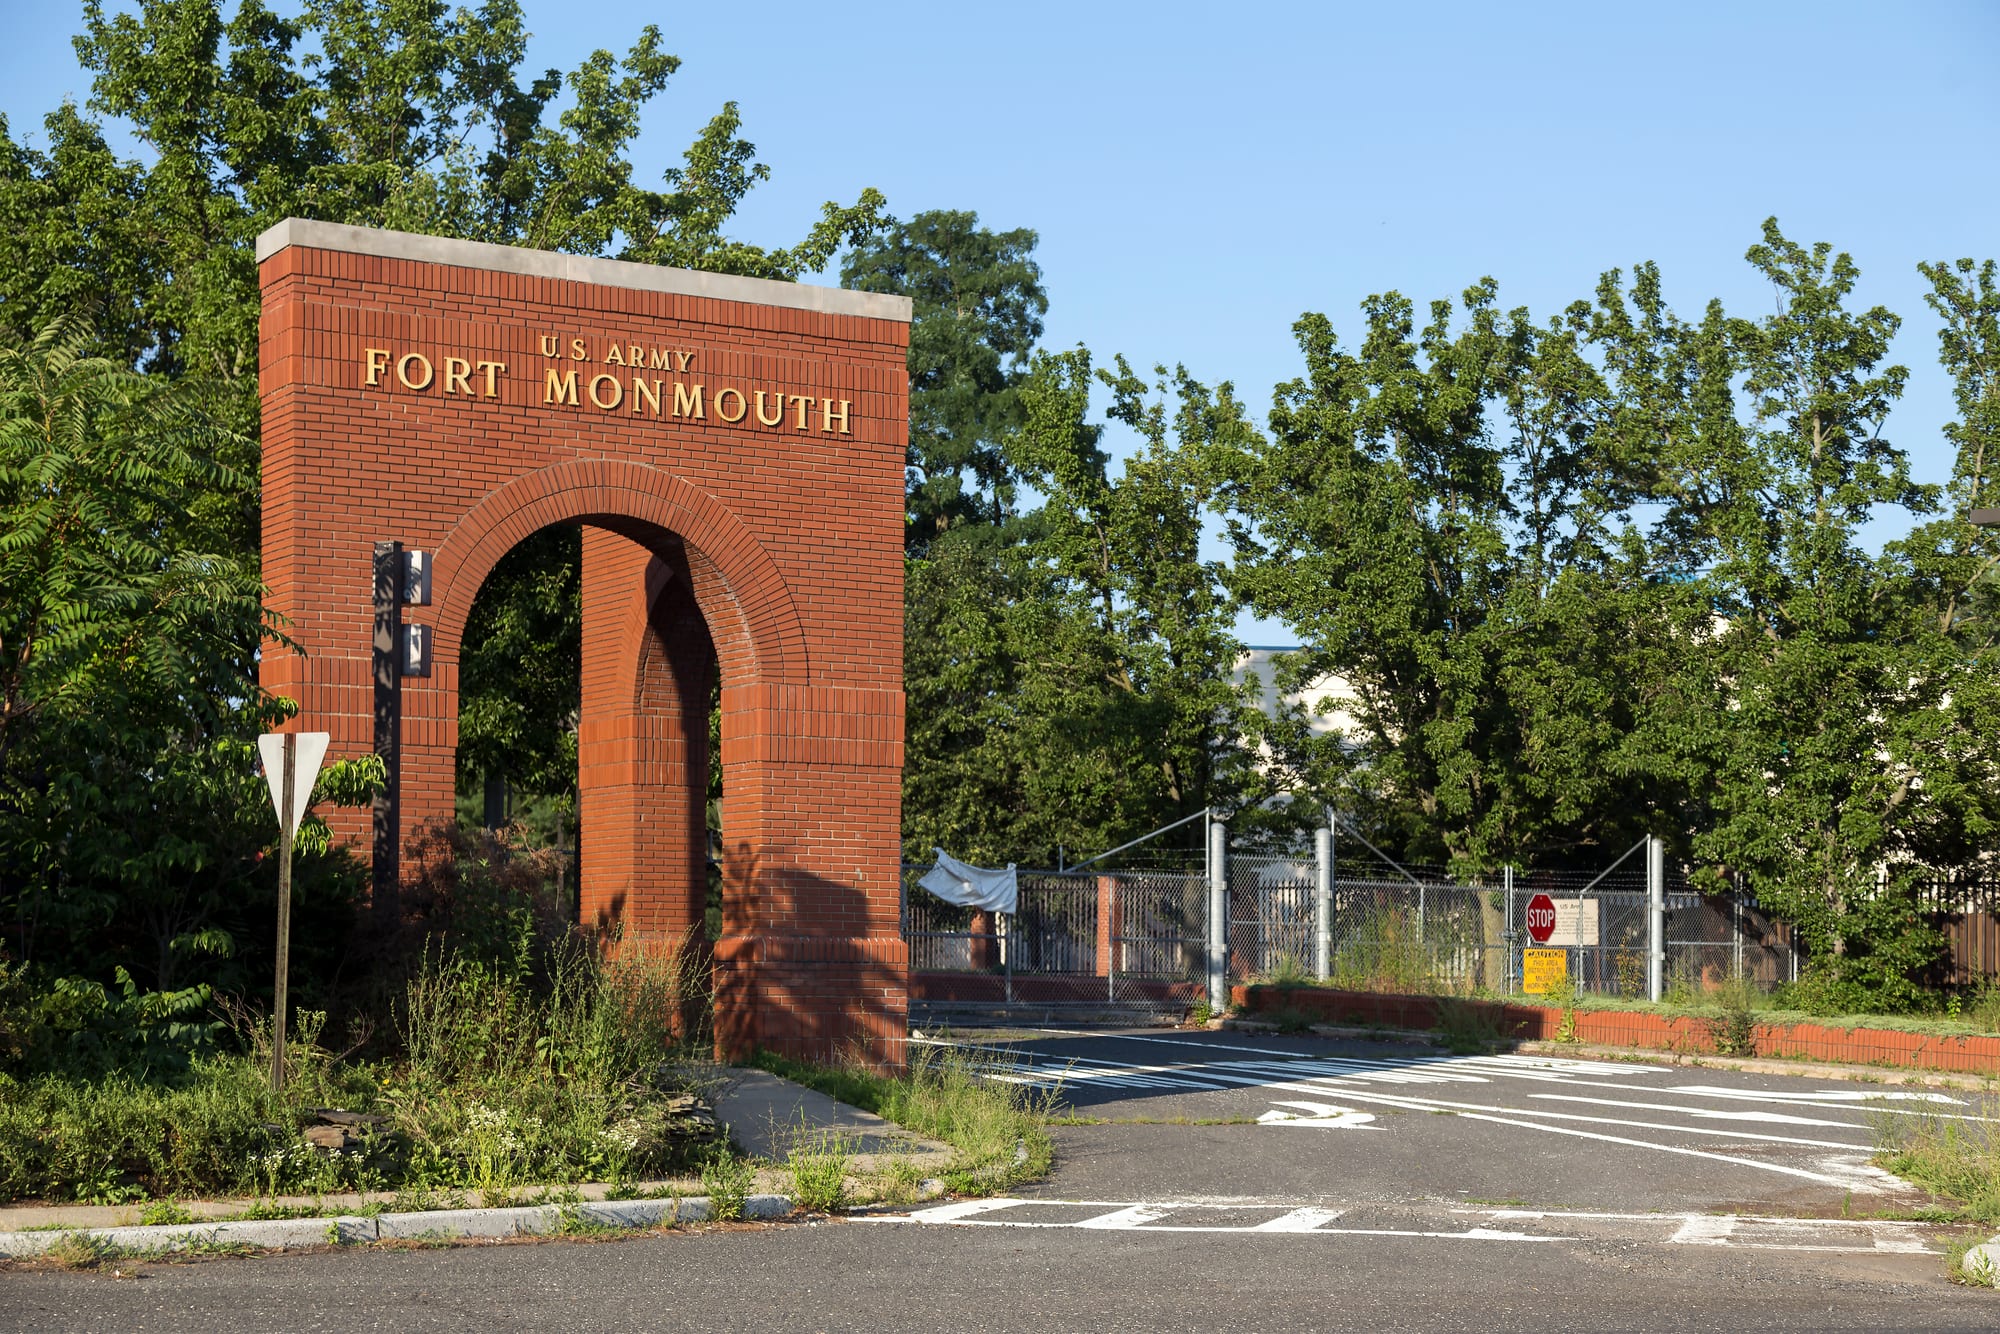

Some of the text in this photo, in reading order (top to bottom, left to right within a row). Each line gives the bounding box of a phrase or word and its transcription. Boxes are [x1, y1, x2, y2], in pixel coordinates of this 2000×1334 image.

[540, 335, 695, 373] U. S. ARMY
[364, 347, 852, 434] FORT MONMOUTH
[1528, 909, 1554, 928] STOP
